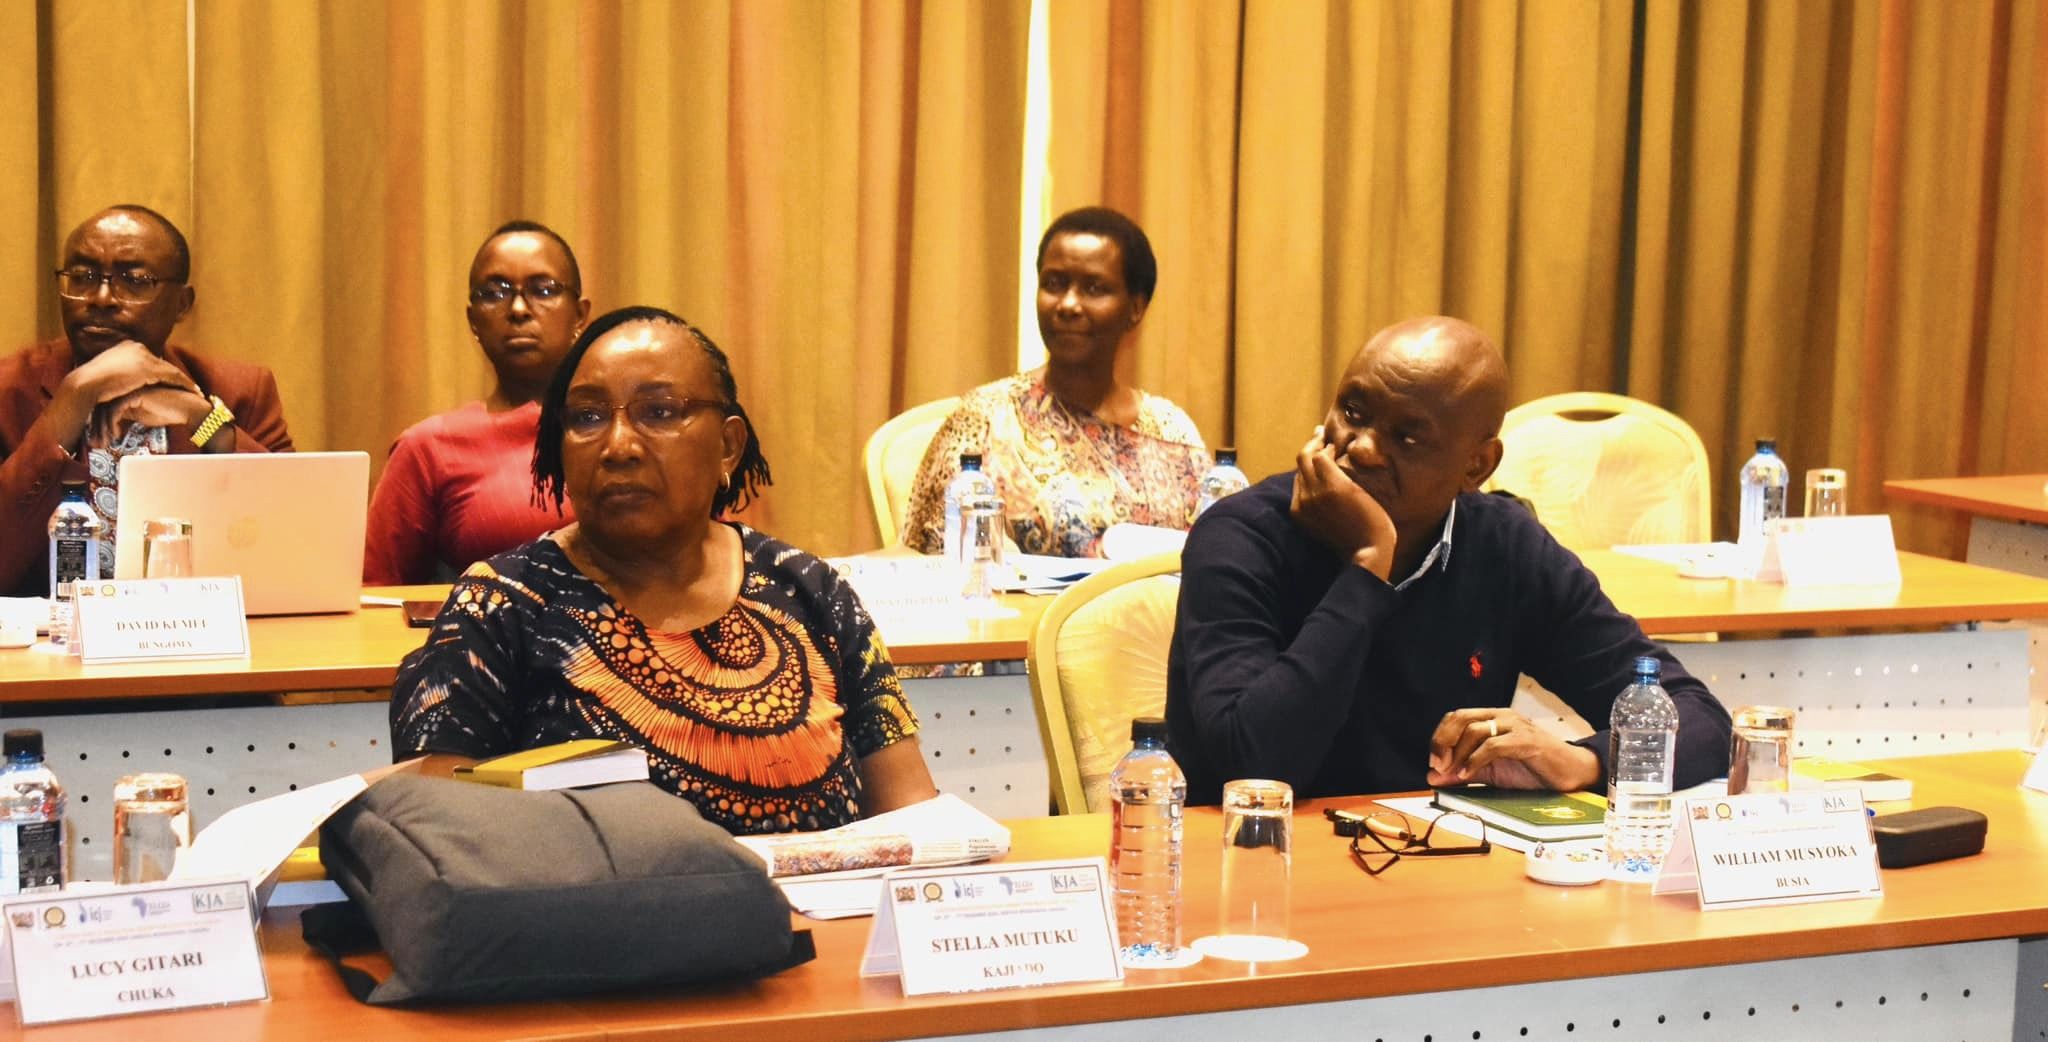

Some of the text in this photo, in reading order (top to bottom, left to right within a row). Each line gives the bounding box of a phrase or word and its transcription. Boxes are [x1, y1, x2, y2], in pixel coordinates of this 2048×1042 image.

[116, 620, 159, 632] DAVID
[138, 640, 193, 650] BUNGOMA
[1713, 843, 1859, 867] WILLIAM MUSYOKA
[1775, 876, 1810, 888] BUSIA
[931, 928, 1079, 953] STELLA MUTUKU
[71, 951, 204, 979] LUCY GITARI
[983, 962, 1044, 979] KAJIDO
[118, 986, 175, 1003] CHUKA
